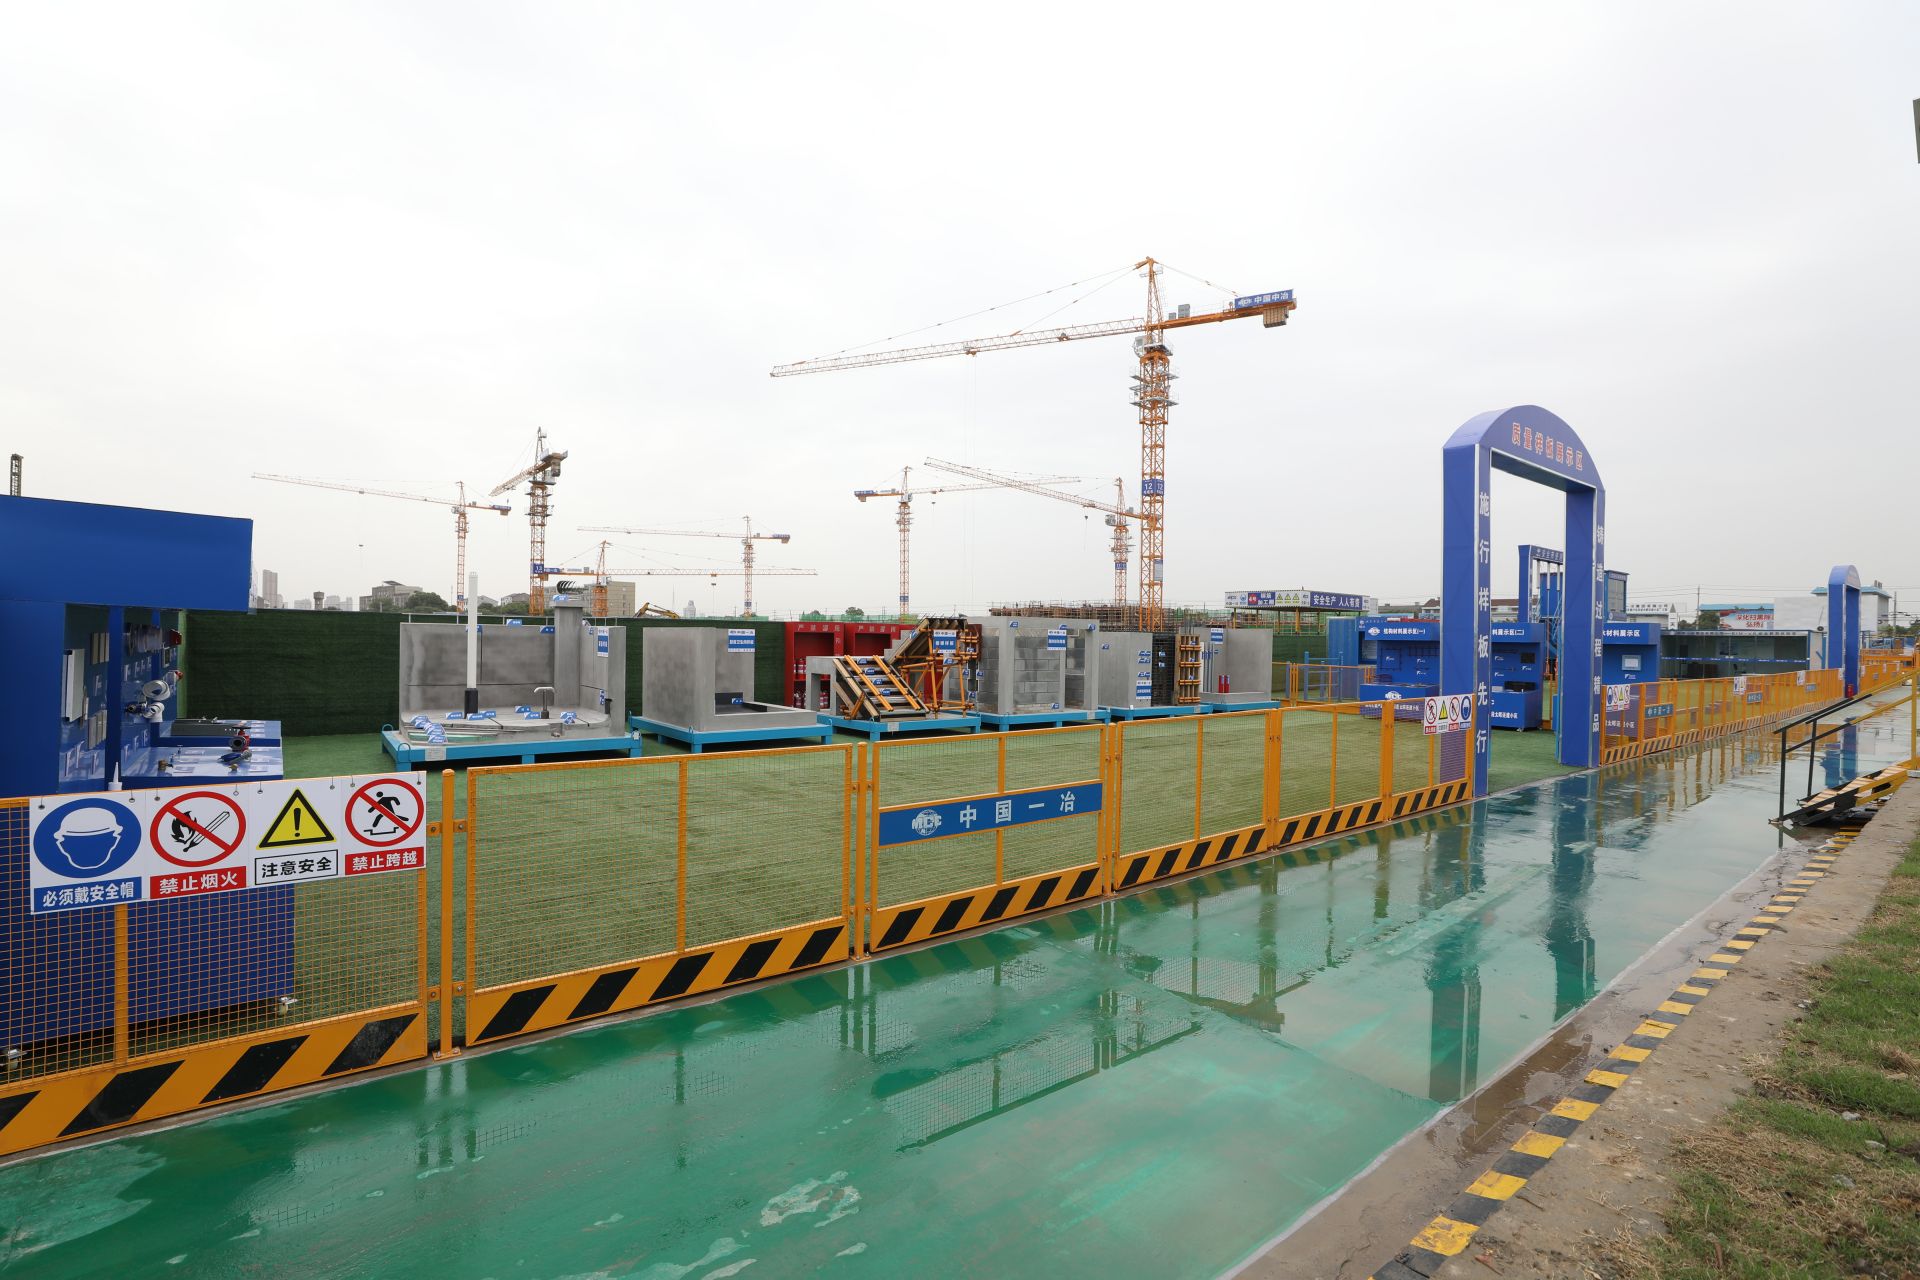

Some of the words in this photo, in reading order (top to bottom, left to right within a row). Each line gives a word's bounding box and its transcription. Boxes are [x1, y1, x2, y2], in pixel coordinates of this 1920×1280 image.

[1254, 291, 1288, 304] 中国中冶
[1512, 422, 1583, 471] 质量样板展示区
[1145, 482, 1153, 490] 12
[1313, 594, 1337, 607] 安全生产
[1476, 492, 1490, 754] 施行样板先行
[959, 790, 1075, 829] 中国一冶
[261, 856, 333, 878] 注意安全
[352, 850, 418, 870] 禁止跨越
[42, 881, 135, 908] 必须戴安全帽
[159, 872, 238, 895] 禁止烟火
